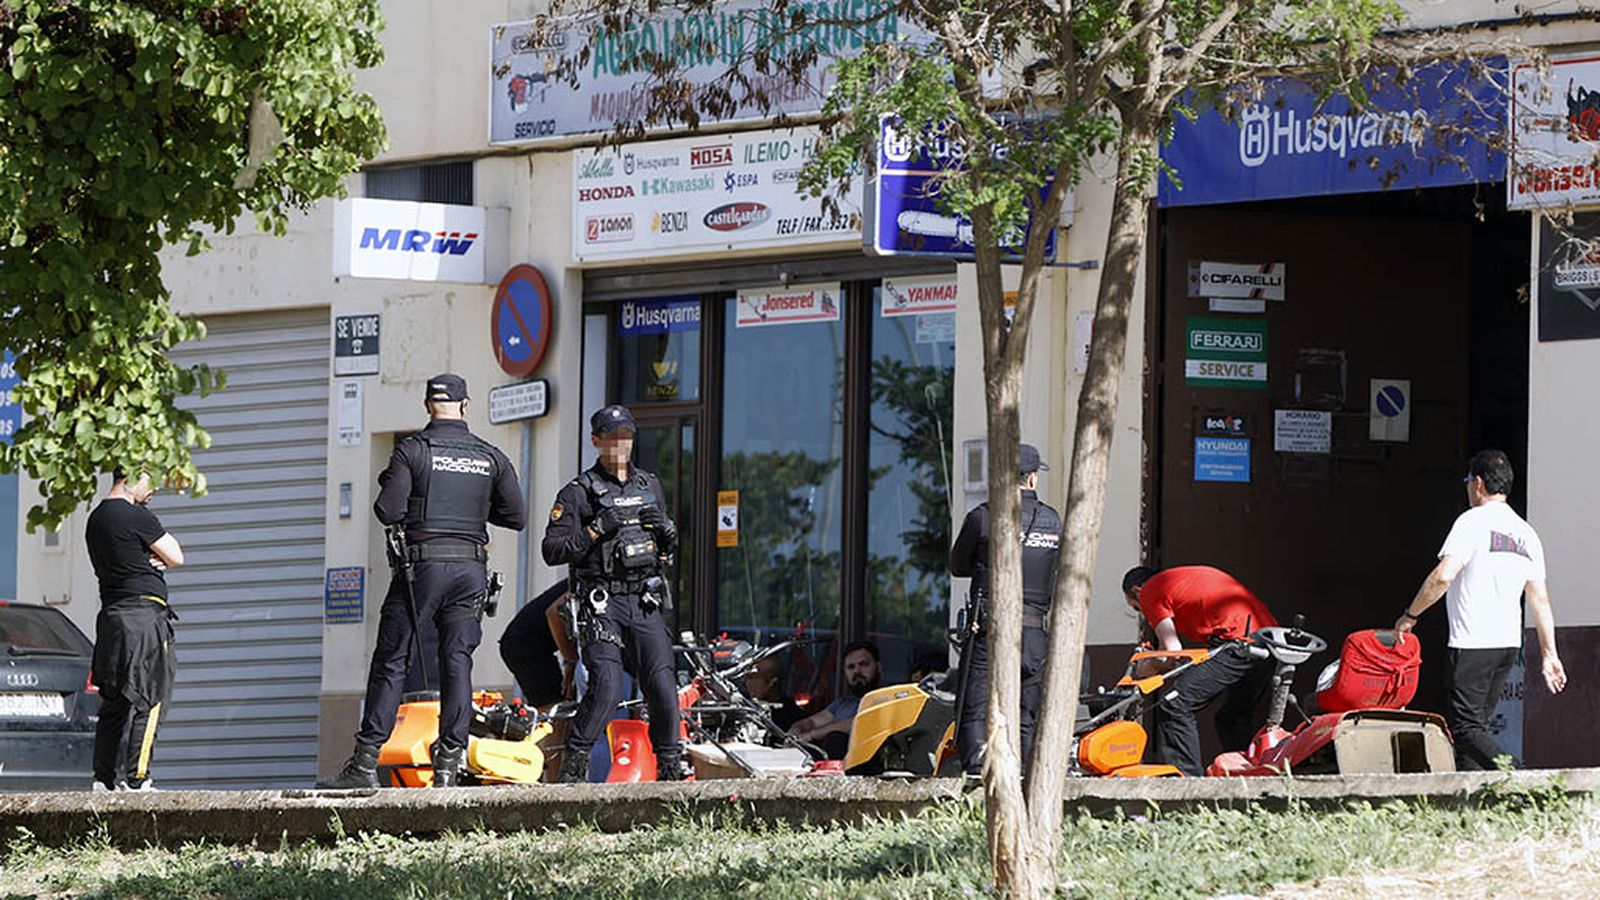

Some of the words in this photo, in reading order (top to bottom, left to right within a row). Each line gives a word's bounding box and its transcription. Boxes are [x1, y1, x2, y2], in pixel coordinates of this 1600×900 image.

[514, 119, 556, 138] SERVICIO
[1273, 109, 1427, 158] Husqvarna
[690, 148, 733, 166] MOSA
[744, 140, 790, 164] ILEMO
[636, 157, 680, 170] Husqvarna
[661, 173, 715, 195] Kawasaki
[737, 174, 759, 187] ESPA
[579, 185, 635, 202] HONDA
[661, 211, 688, 233] BENZA
[360, 228, 478, 256] MRW
[1210, 273, 1282, 286] CIFARELLI
[762, 291, 814, 311] Jonsered
[636, 305, 701, 329] Husqvarna
[338, 319, 349, 338] SE
[351, 316, 378, 338] VENDE
[1194, 334, 1259, 348] FERRARI
[1199, 362, 1255, 378] SERVICE
[1198, 440, 1248, 451] HYUNDAI
[432, 464, 490, 476] NACIONAL
